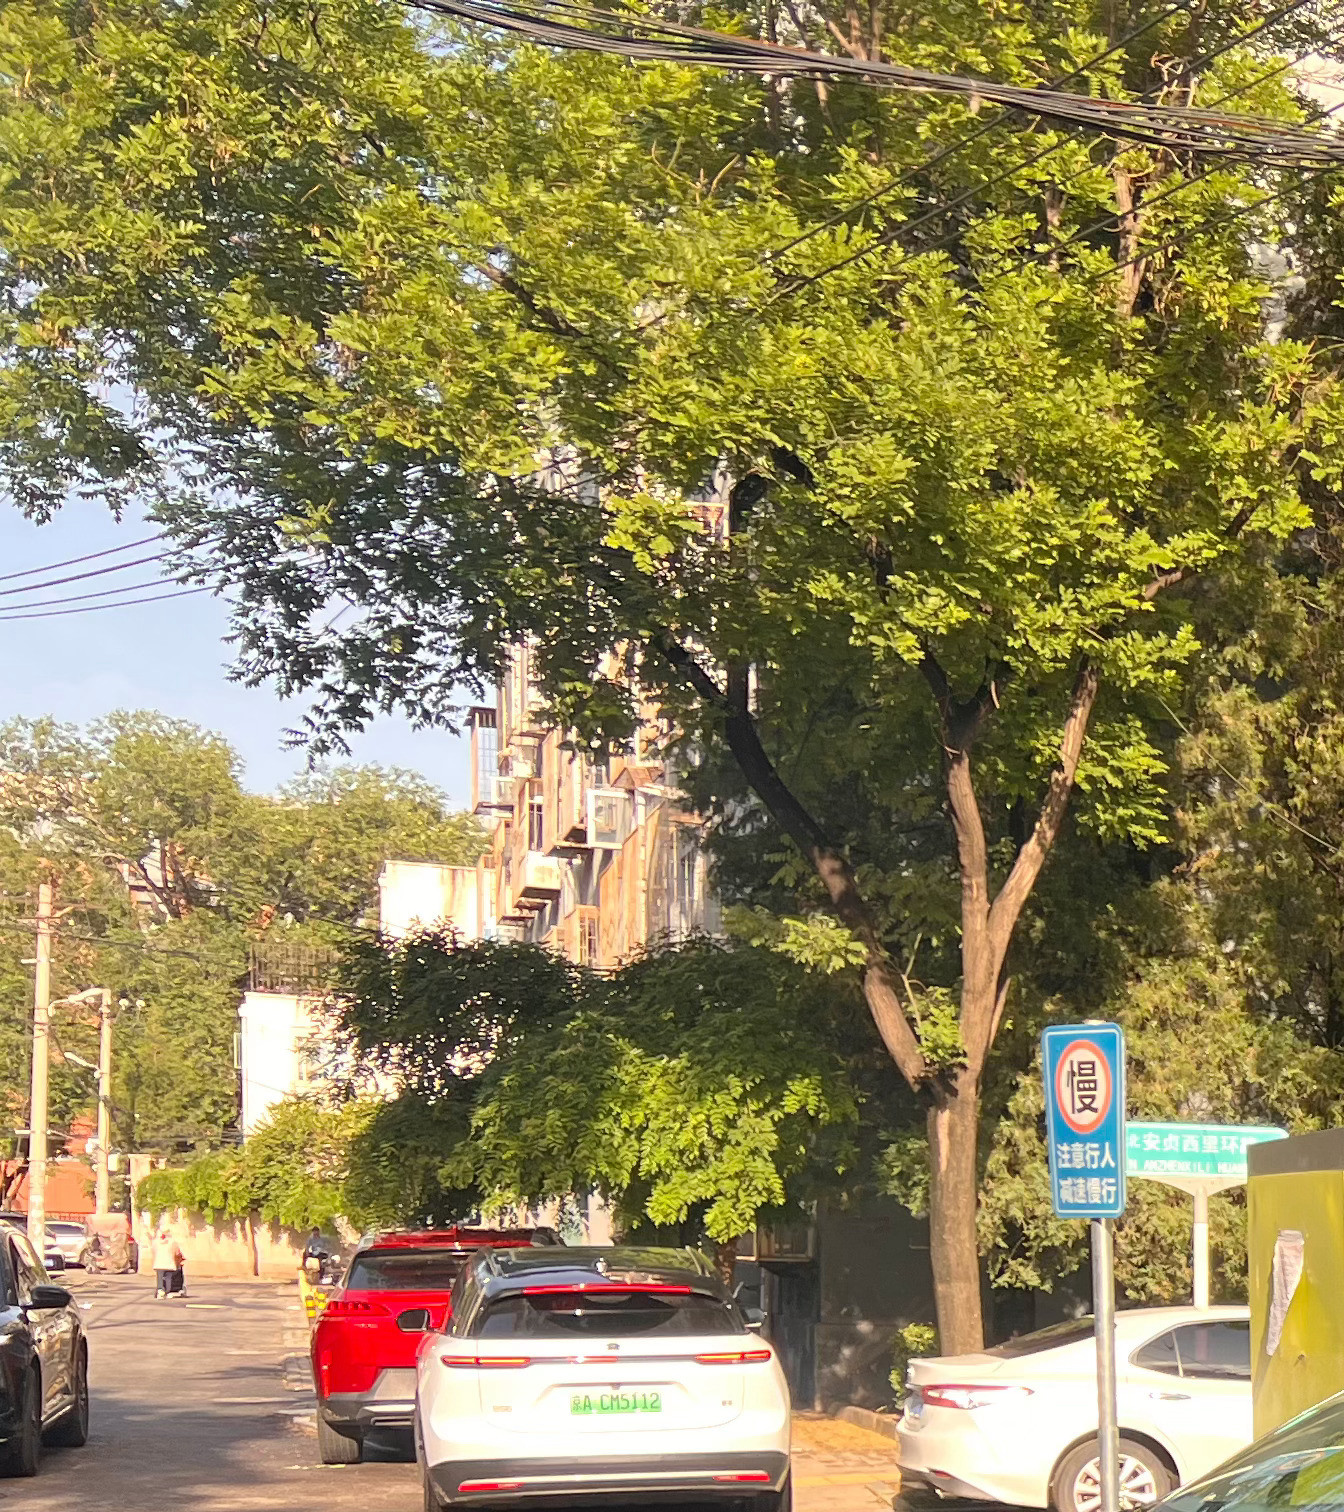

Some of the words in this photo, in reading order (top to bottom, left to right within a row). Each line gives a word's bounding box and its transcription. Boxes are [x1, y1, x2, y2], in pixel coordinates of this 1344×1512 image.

[1067, 1059, 1098, 1115] 慢
[1056, 1142, 1116, 1169] 注意行人
[1058, 1176, 1117, 1204] 减速慢行
[600, 1391, 661, 1411] CM5112
